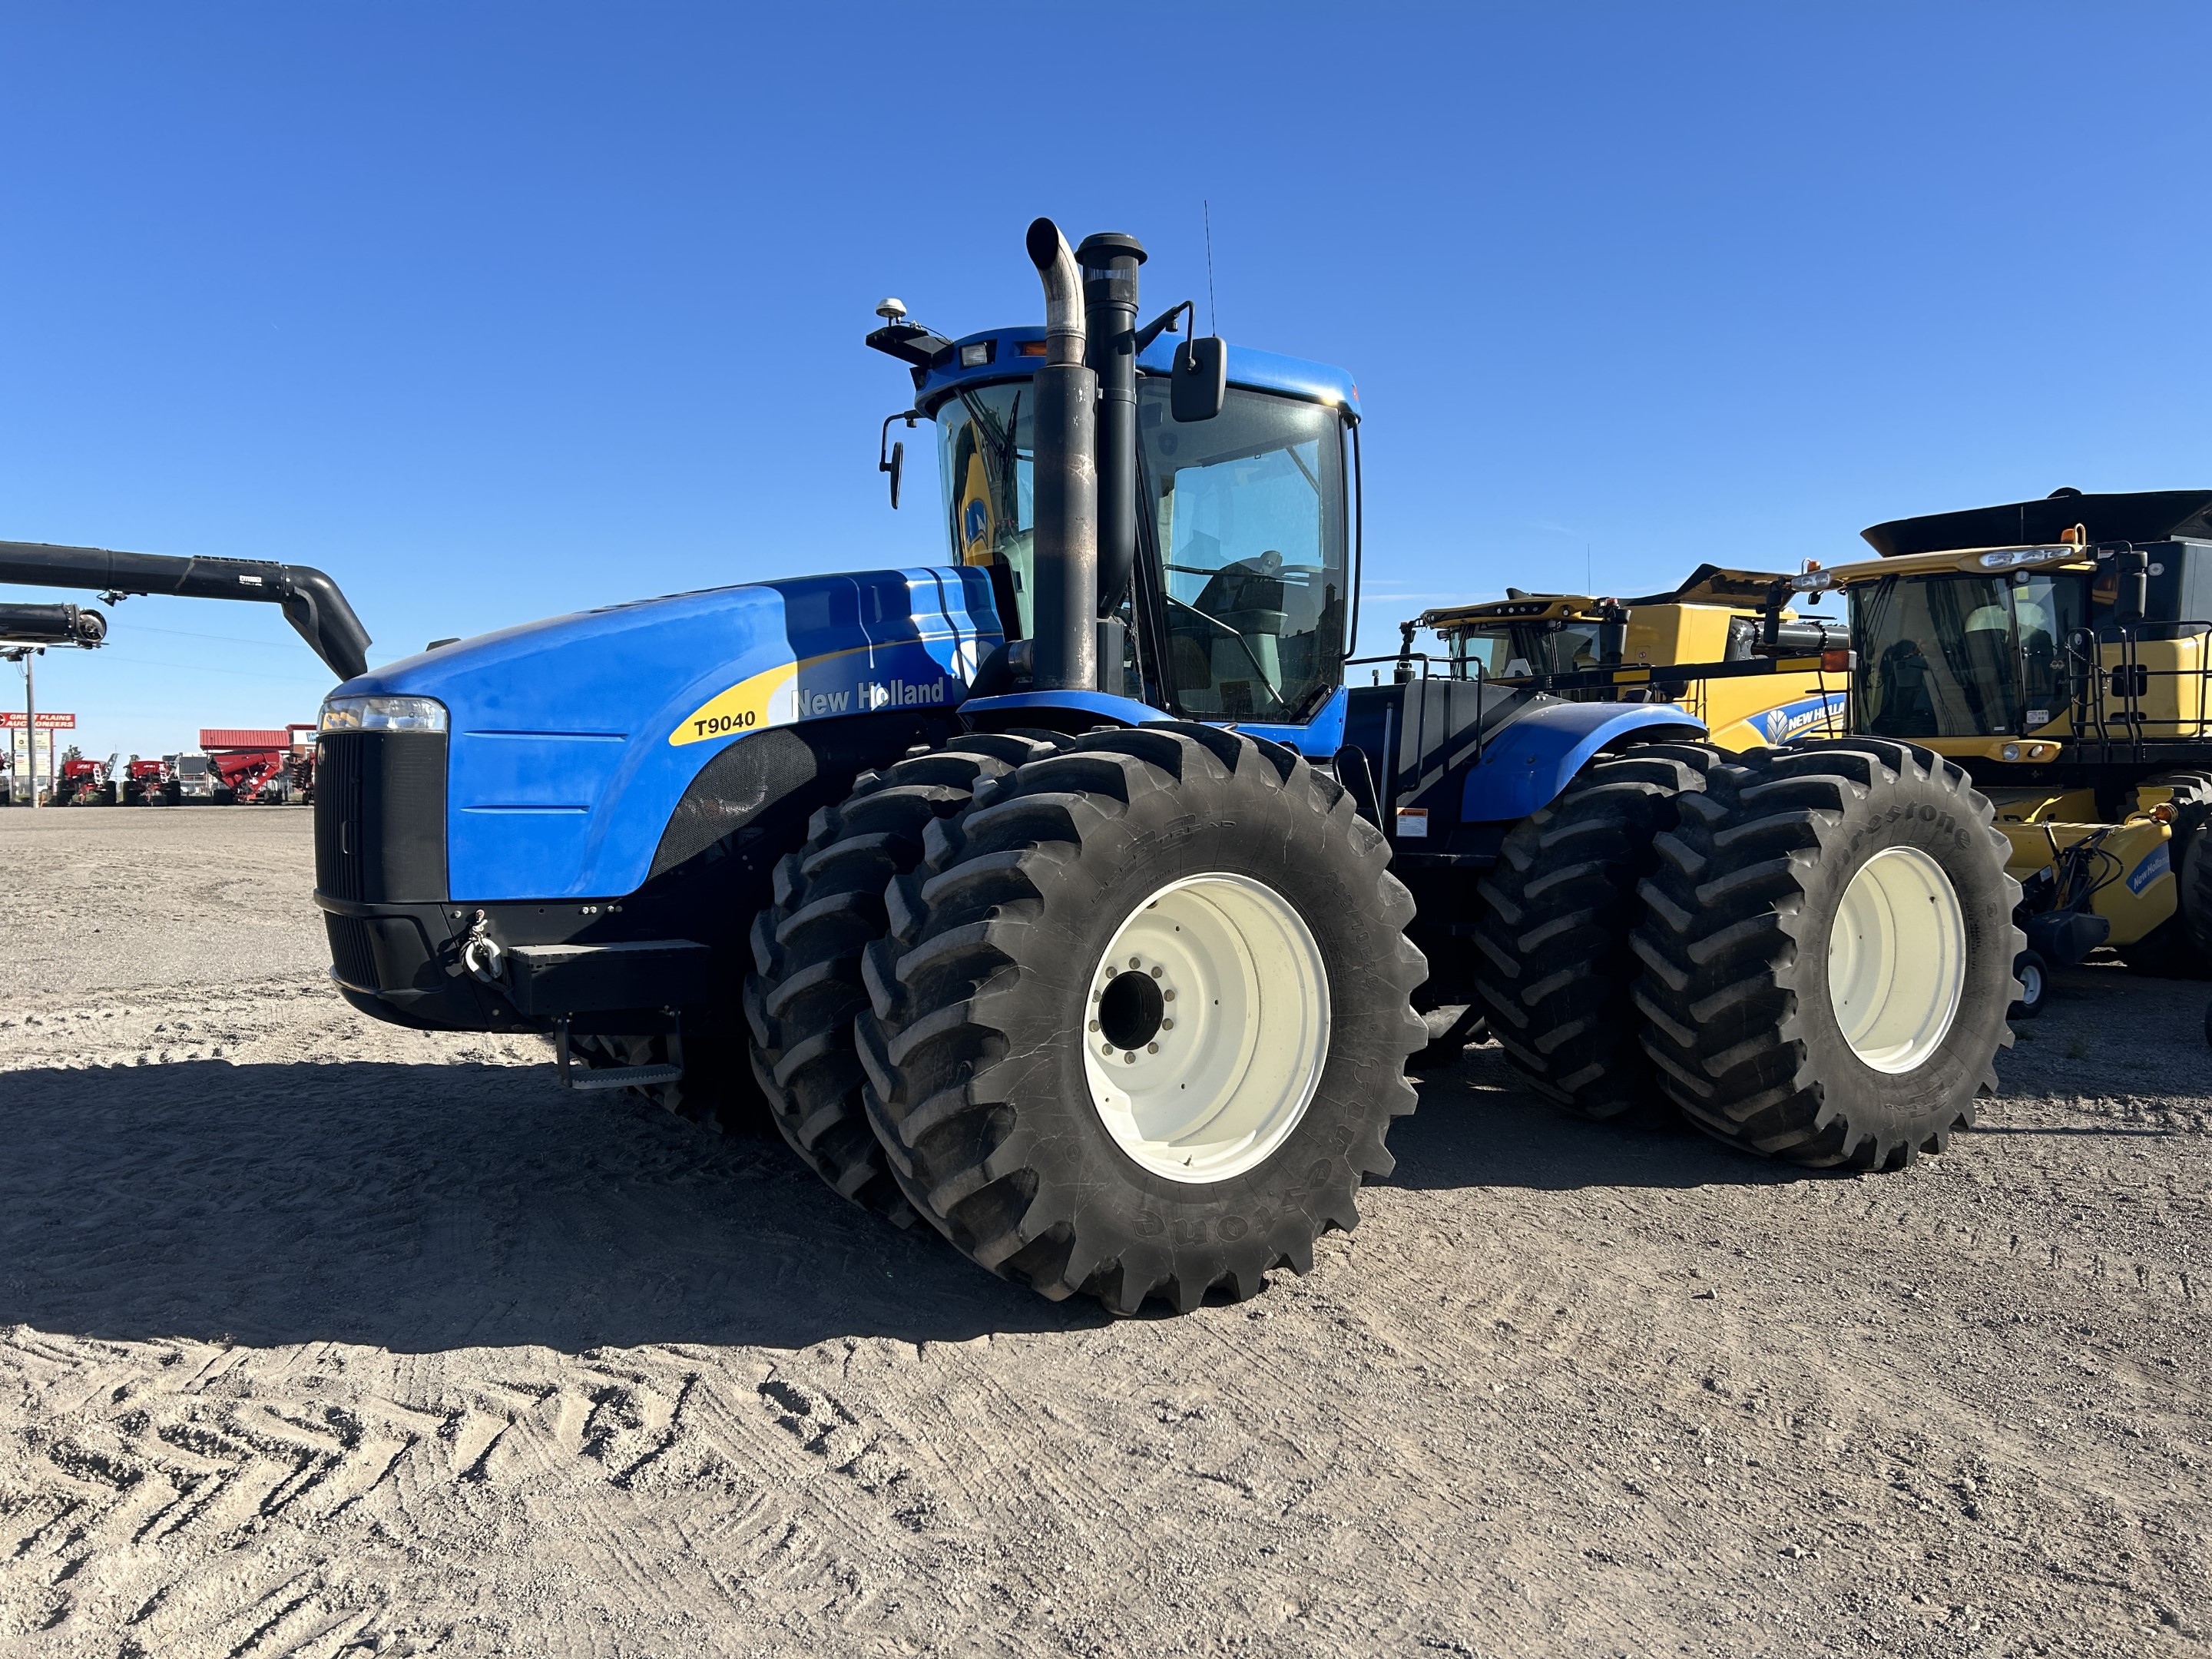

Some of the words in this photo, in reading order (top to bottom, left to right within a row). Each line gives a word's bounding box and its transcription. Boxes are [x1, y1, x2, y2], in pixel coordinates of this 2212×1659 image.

[791, 689, 849, 718] New
[858, 677, 945, 710] Holland
[694, 710, 756, 737] T9040
[1789, 711, 1813, 731] NEW
[1813, 701, 1846, 721] HOLLA
[2134, 869, 2147, 890] New
